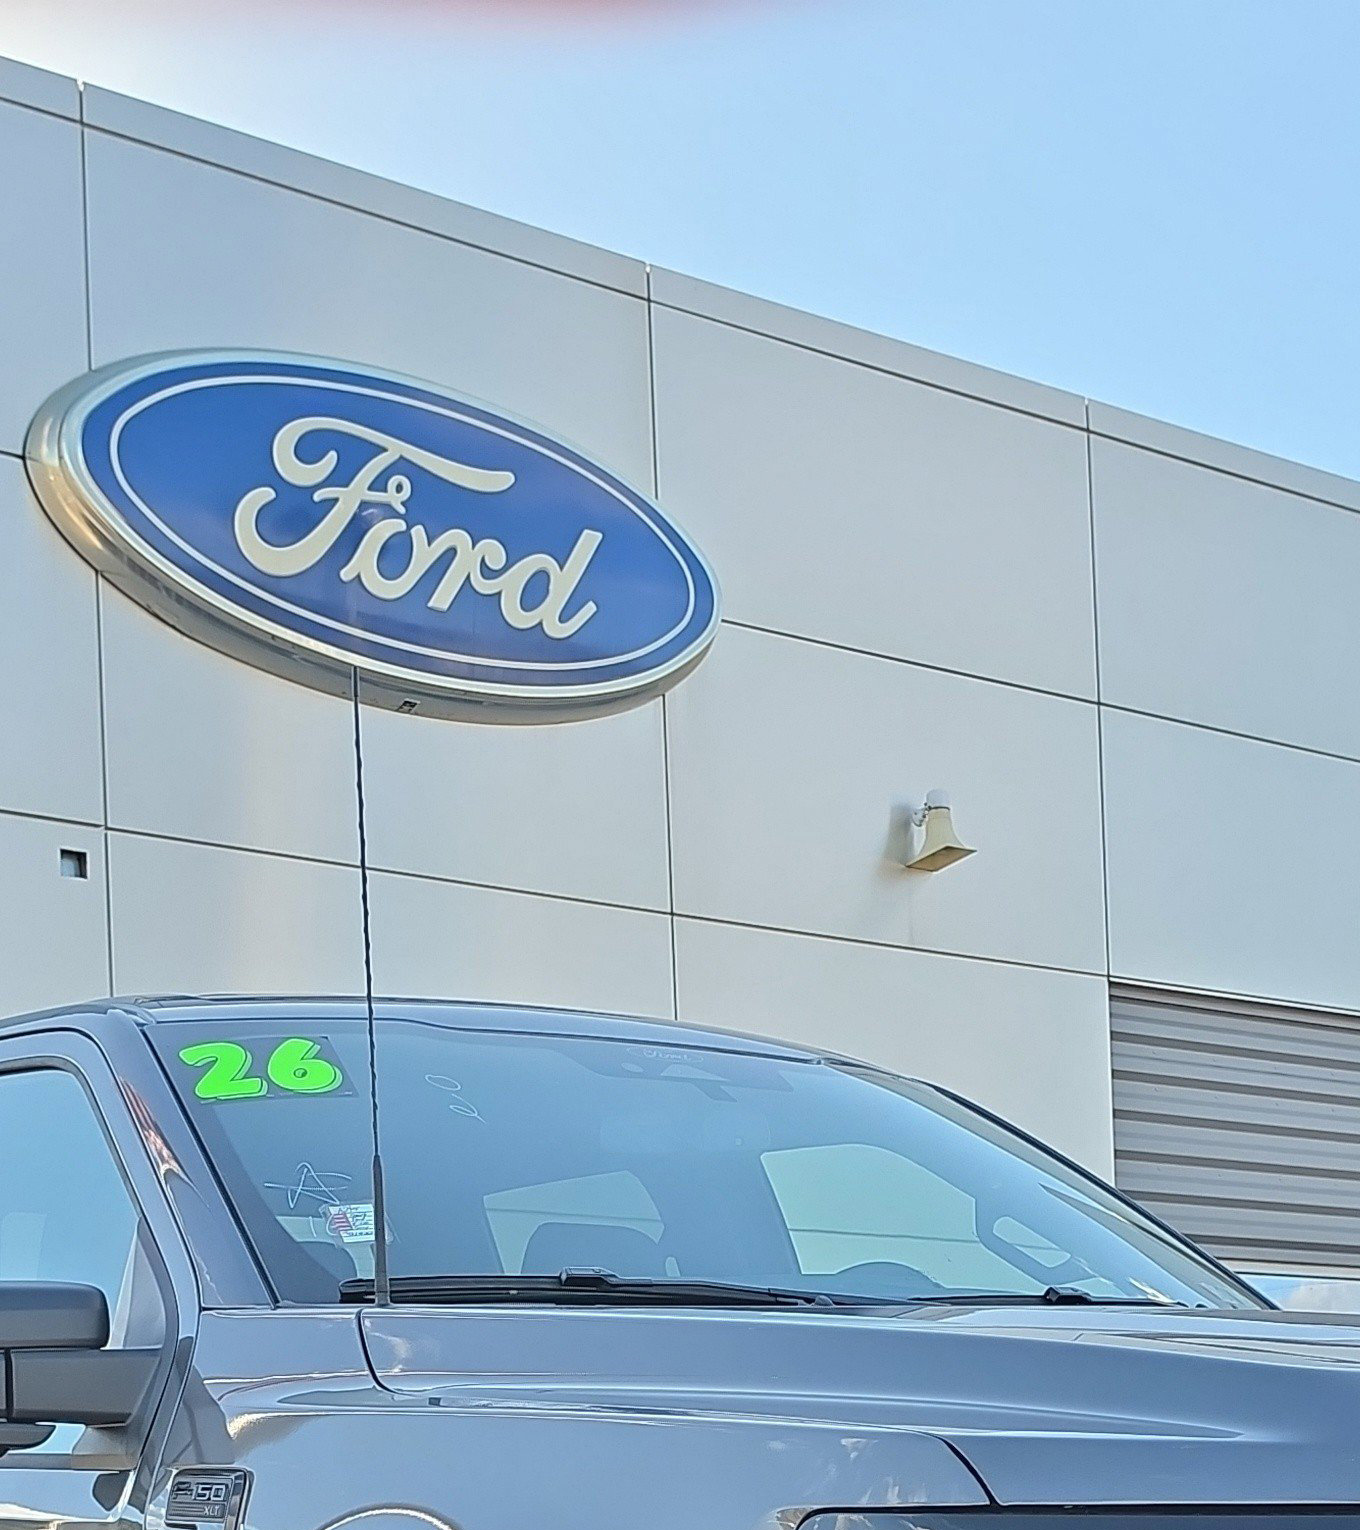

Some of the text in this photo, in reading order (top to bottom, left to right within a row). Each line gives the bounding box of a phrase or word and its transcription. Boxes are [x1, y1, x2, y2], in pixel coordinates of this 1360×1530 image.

[233, 416, 603, 640] Ford
[178, 1036, 343, 1101] 26
[172, 1480, 228, 1501] F-150
[202, 1504, 221, 1517] XLT
